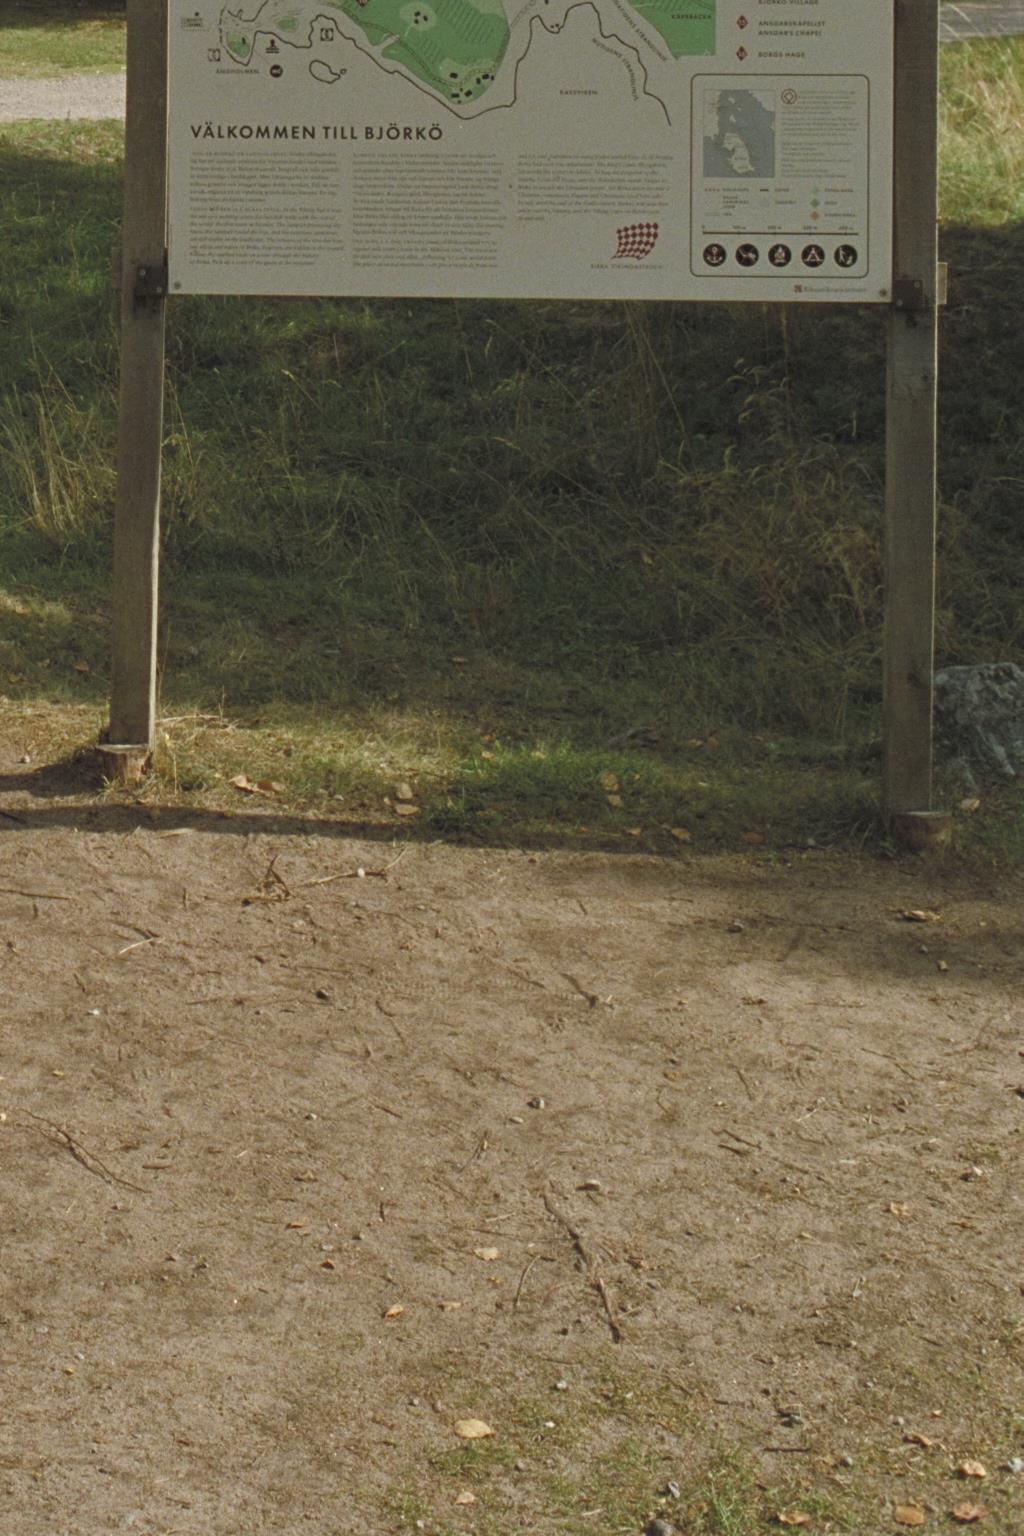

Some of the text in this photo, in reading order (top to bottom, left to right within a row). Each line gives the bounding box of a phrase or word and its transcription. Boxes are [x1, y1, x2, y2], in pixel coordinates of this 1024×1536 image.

[190, 121, 444, 141] VÄLKOMMEN TILL BJÖRKÖ
